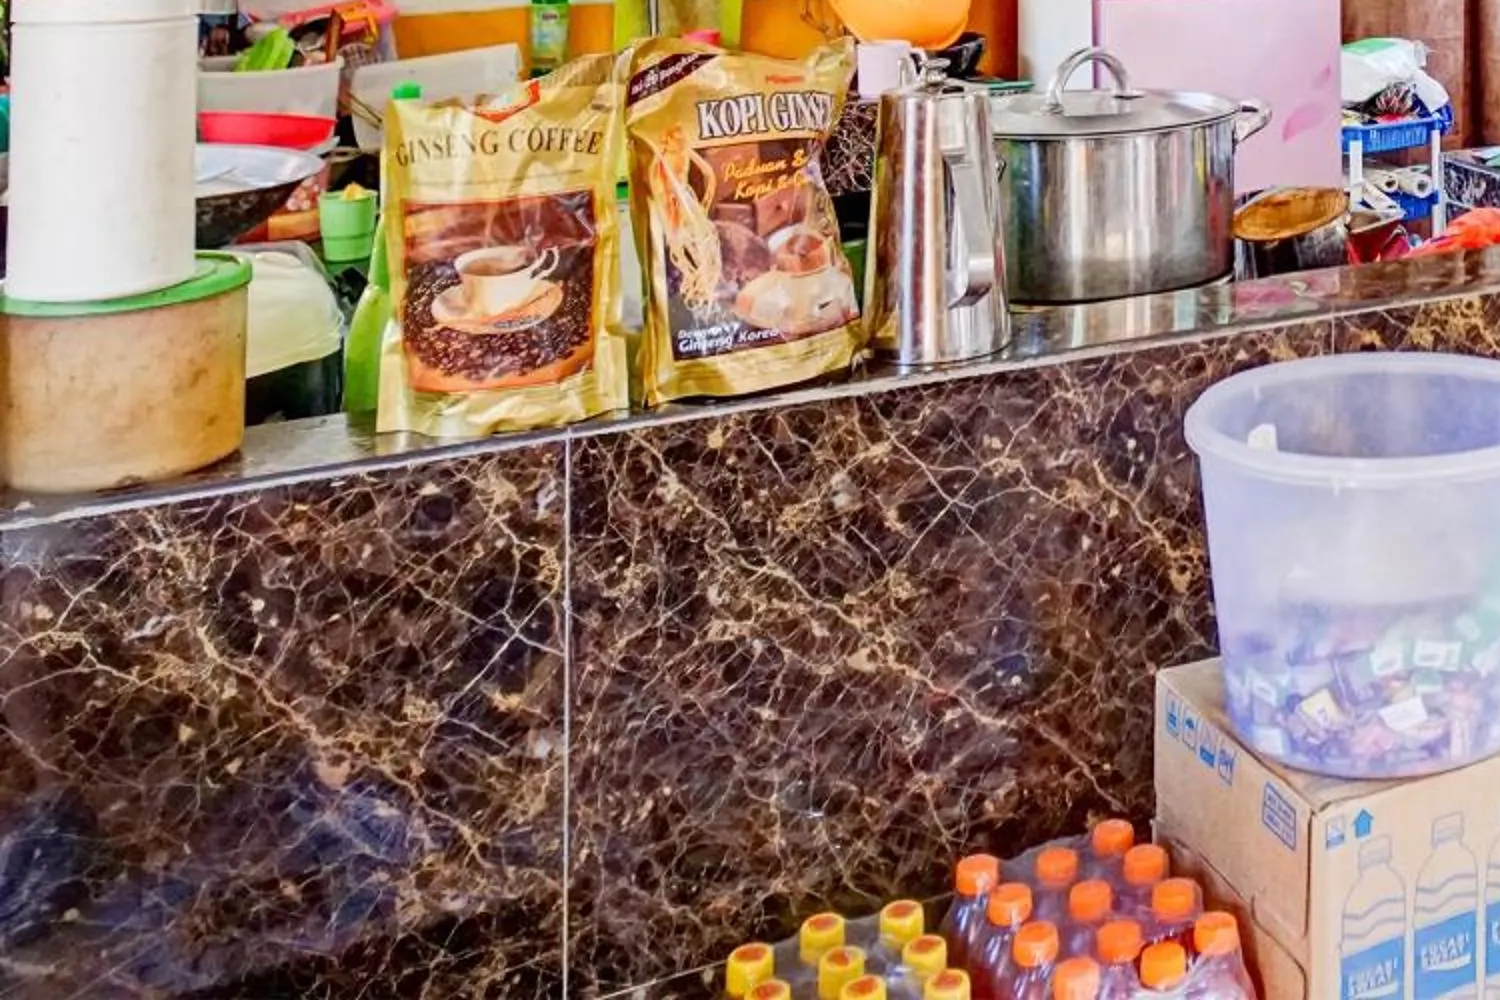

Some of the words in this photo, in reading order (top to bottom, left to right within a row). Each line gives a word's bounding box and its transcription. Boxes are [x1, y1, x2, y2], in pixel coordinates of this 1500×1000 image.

[696, 93, 769, 140] KOPI
[395, 128, 499, 168] GINSENG
[508, 126, 604, 156] COFFEE
